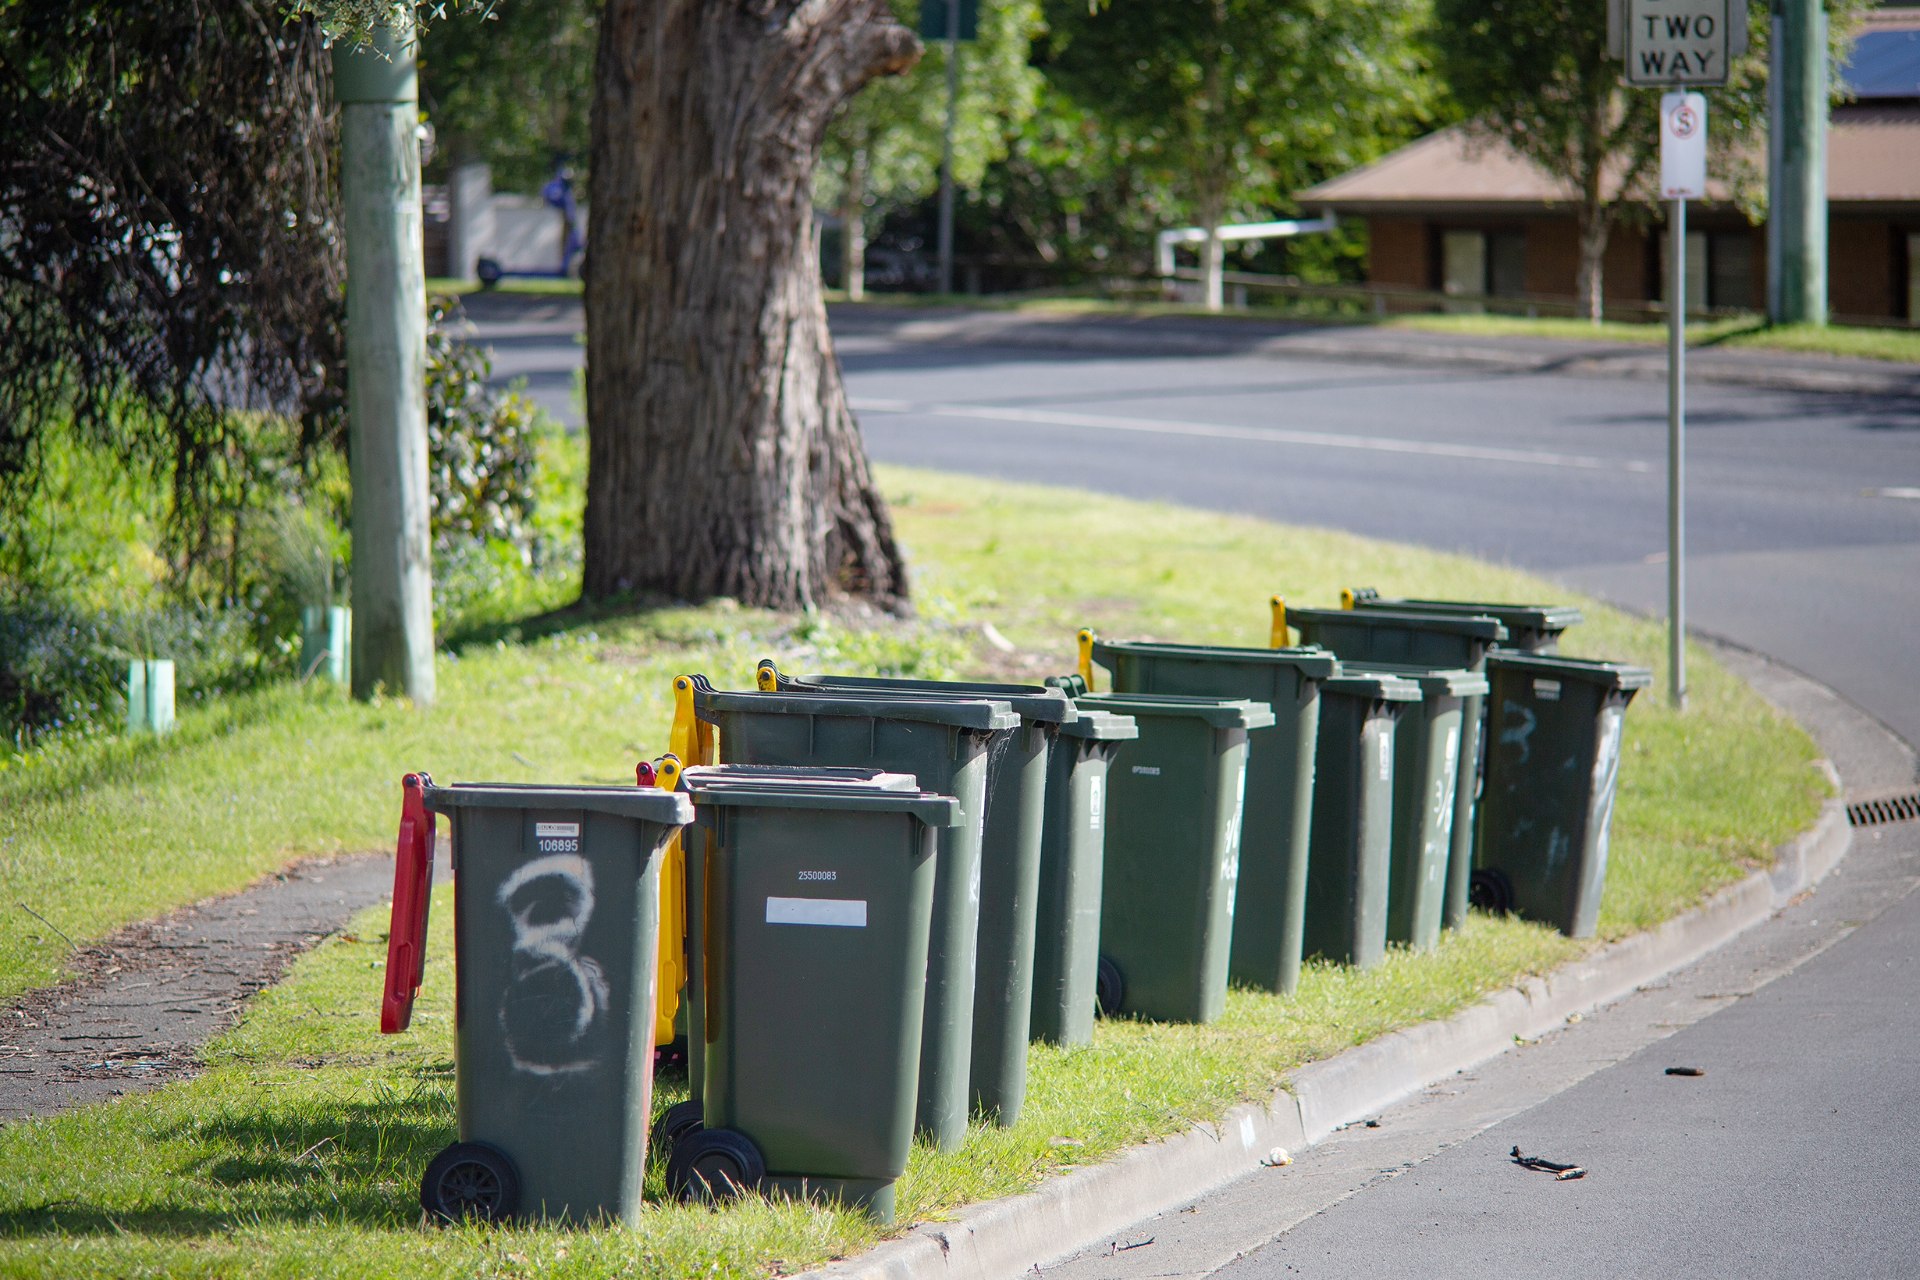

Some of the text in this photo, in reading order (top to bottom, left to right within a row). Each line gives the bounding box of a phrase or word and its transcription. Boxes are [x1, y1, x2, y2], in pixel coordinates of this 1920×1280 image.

[1643, 14, 1715, 39] TWO
[1641, 51, 1714, 75] WAY
[1677, 111, 1691, 134] S
[539, 839, 578, 851] 106895
[798, 871, 837, 880] 25500083
